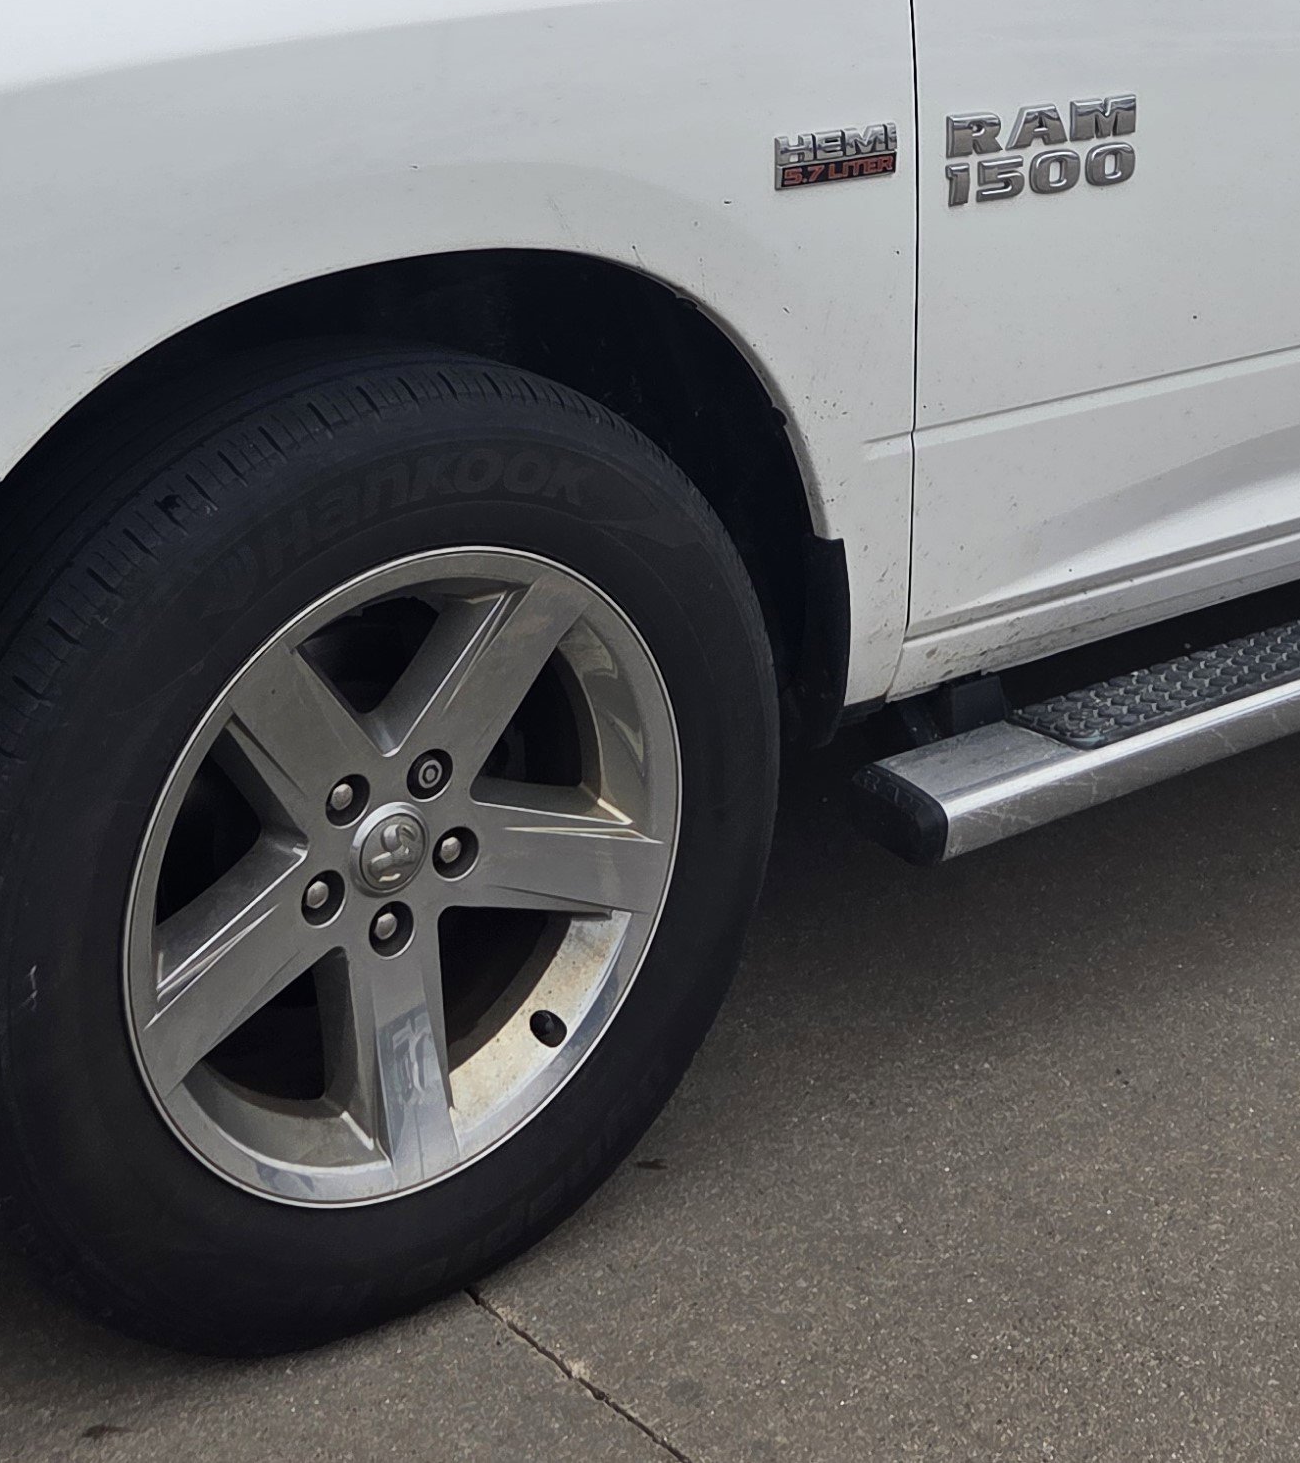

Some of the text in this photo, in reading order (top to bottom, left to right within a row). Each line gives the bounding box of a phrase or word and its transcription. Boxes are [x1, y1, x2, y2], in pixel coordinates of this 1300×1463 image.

[774, 122, 897, 166] HEMI
[945, 93, 1137, 159] RAM
[783, 154, 894, 187] 5.7 LITER
[945, 141, 1137, 208] 1500
